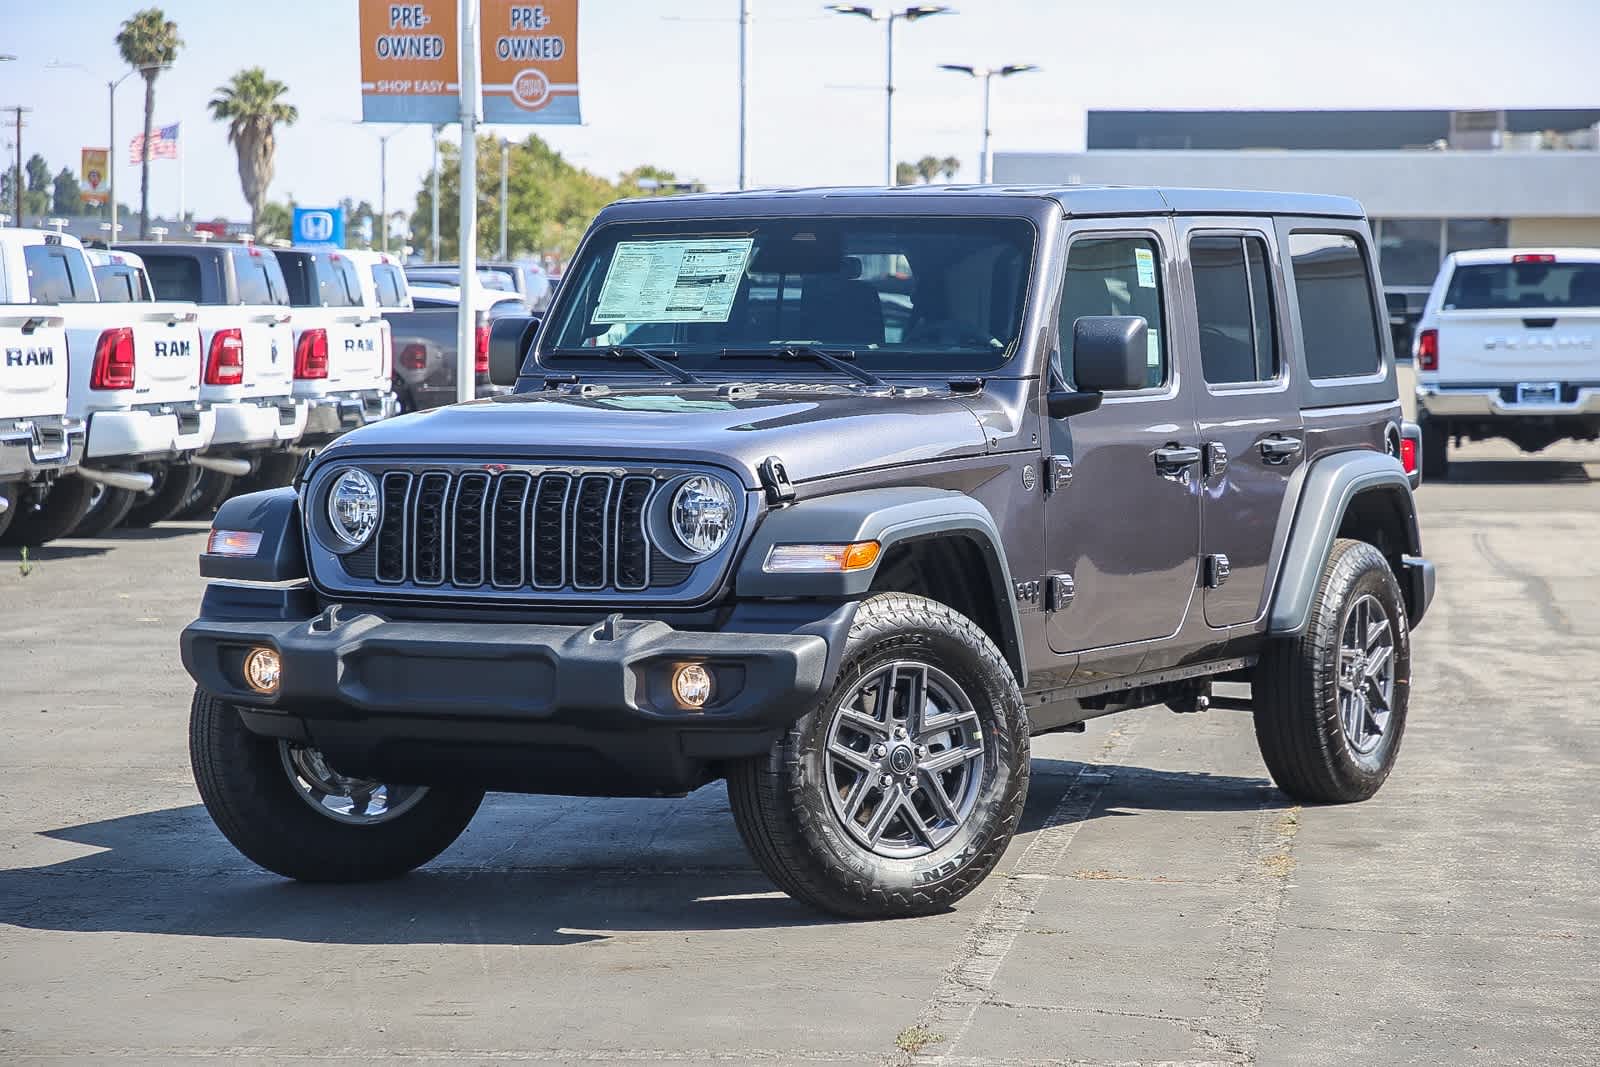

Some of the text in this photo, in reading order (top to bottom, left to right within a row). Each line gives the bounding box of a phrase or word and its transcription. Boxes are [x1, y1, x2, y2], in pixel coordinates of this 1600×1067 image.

[390, 6, 430, 28] PRE-
[511, 7, 549, 29] PRE-
[377, 36, 444, 59] OWNED
[498, 37, 564, 60] OWNED
[377, 80, 445, 93] SHOP EASY
[154, 340, 190, 357] RAM
[345, 339, 374, 352] RAM
[6, 347, 53, 366] RAM
